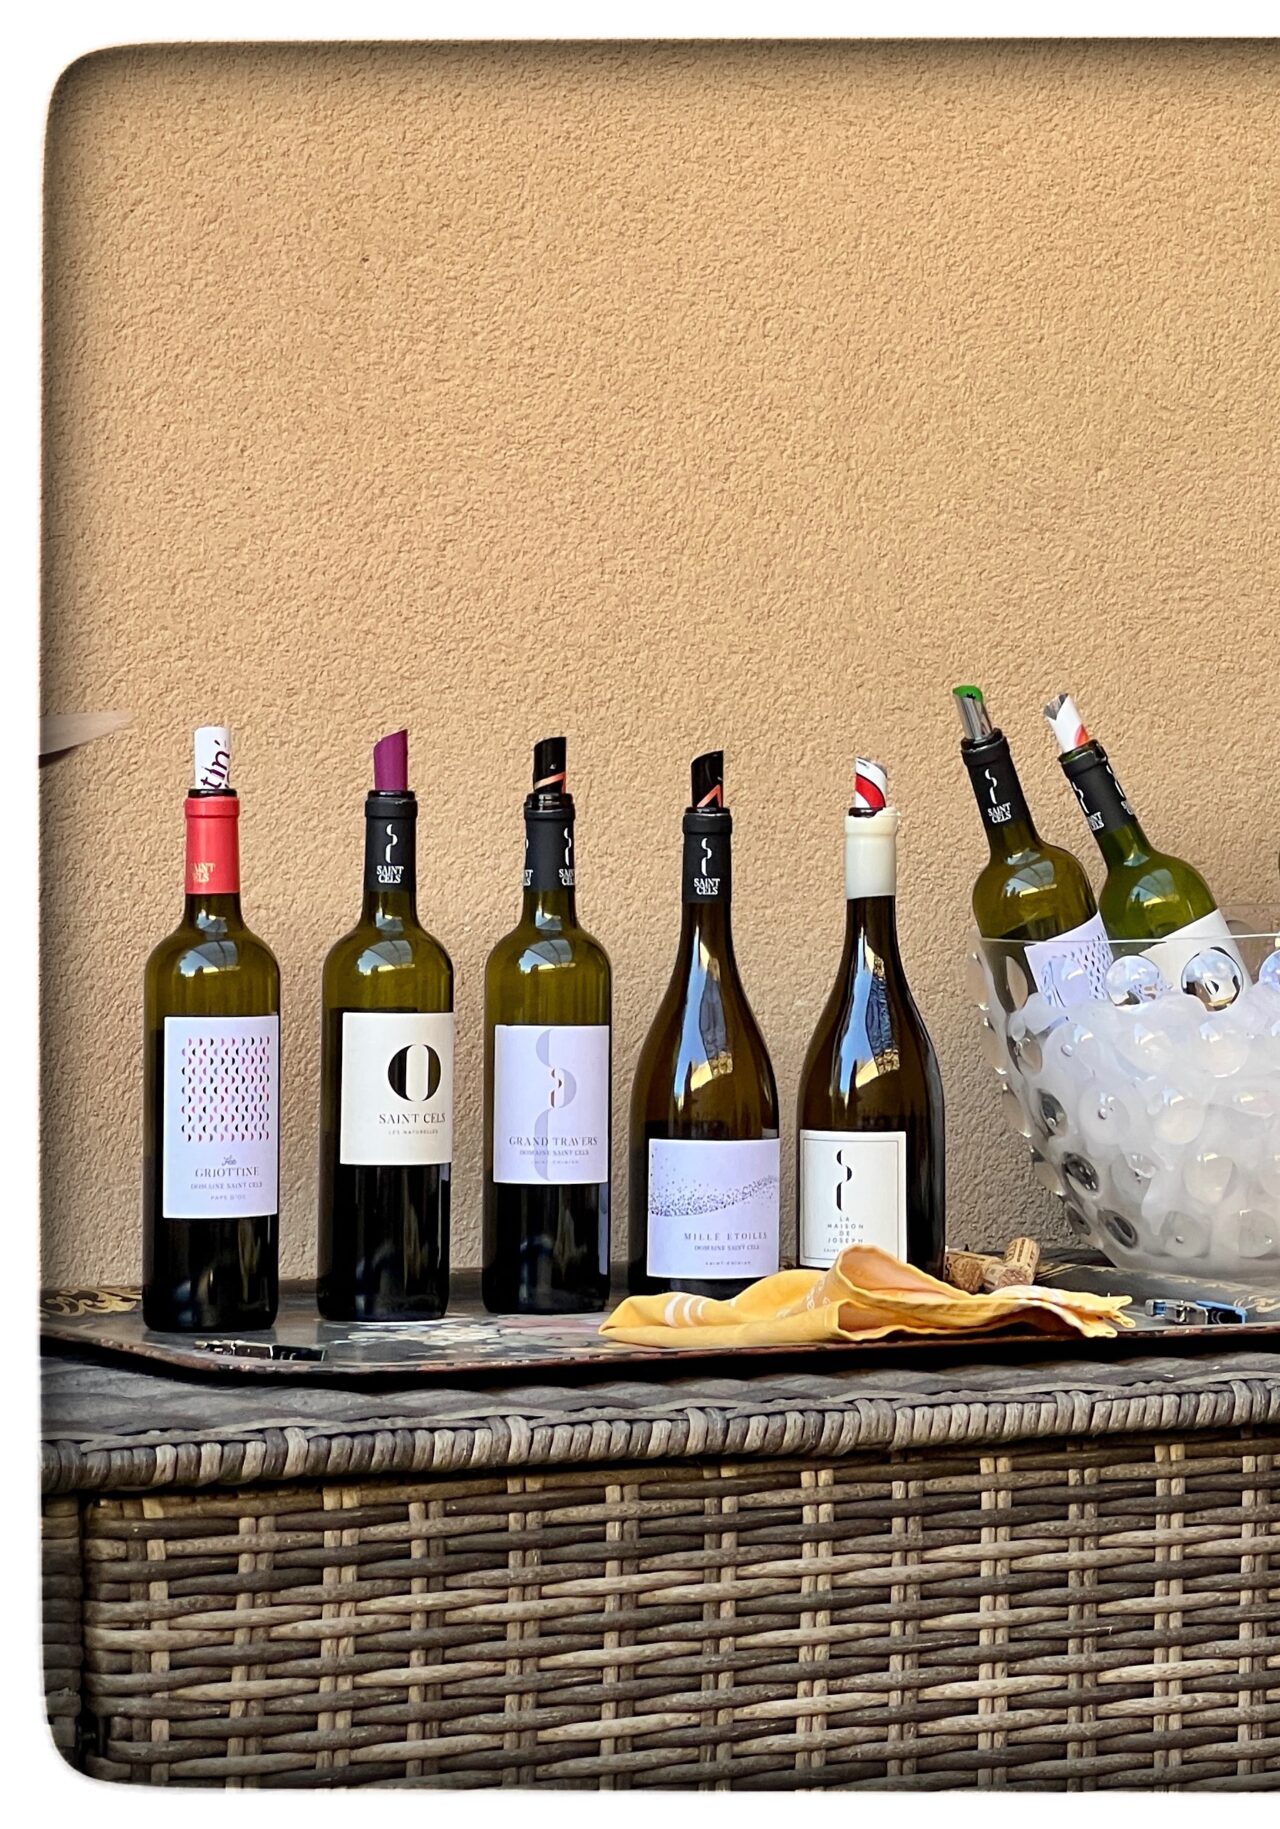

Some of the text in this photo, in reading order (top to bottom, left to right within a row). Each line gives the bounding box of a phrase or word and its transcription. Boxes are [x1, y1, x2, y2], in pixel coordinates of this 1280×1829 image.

[988, 802, 1012, 817] SAINT
[991, 811, 1012, 824] CELS
[376, 865, 404, 875] SAINT
[378, 874, 401, 883] CELS
[693, 877, 720, 888] SAINT
[696, 886, 718, 895] CELS
[379, 1113, 446, 1124] SAINT CELS
[509, 1136, 598, 1146] GRAND TRAVERS
[195, 1166, 260, 1178] GRIOTTINE
[684, 1233, 721, 1241] MILLE
